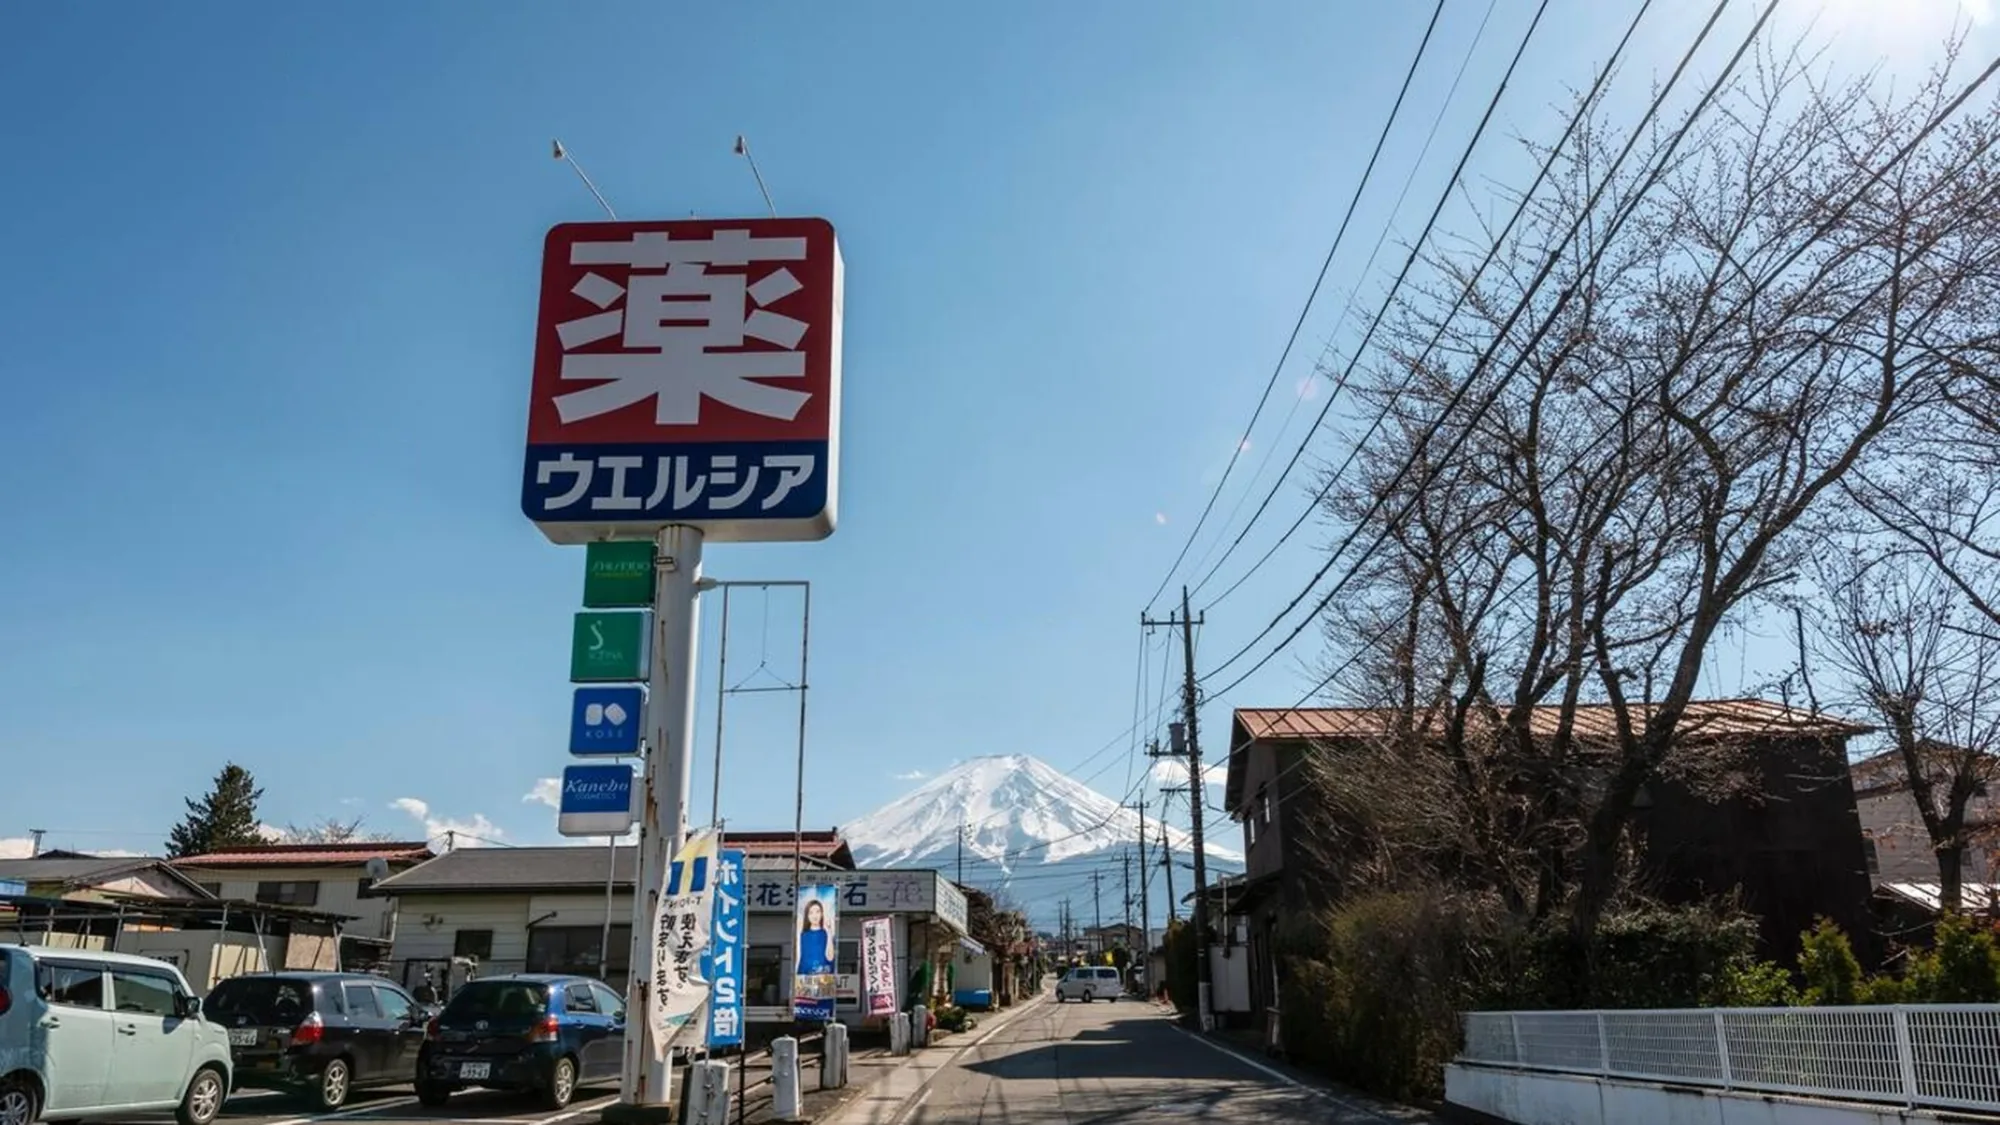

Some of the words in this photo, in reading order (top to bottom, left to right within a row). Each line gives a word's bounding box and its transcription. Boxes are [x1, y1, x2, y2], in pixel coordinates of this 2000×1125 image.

[552, 229, 812, 425] 薬
[537, 453, 815, 510] ウエルシア
[565, 778, 629, 793] Kanebo
